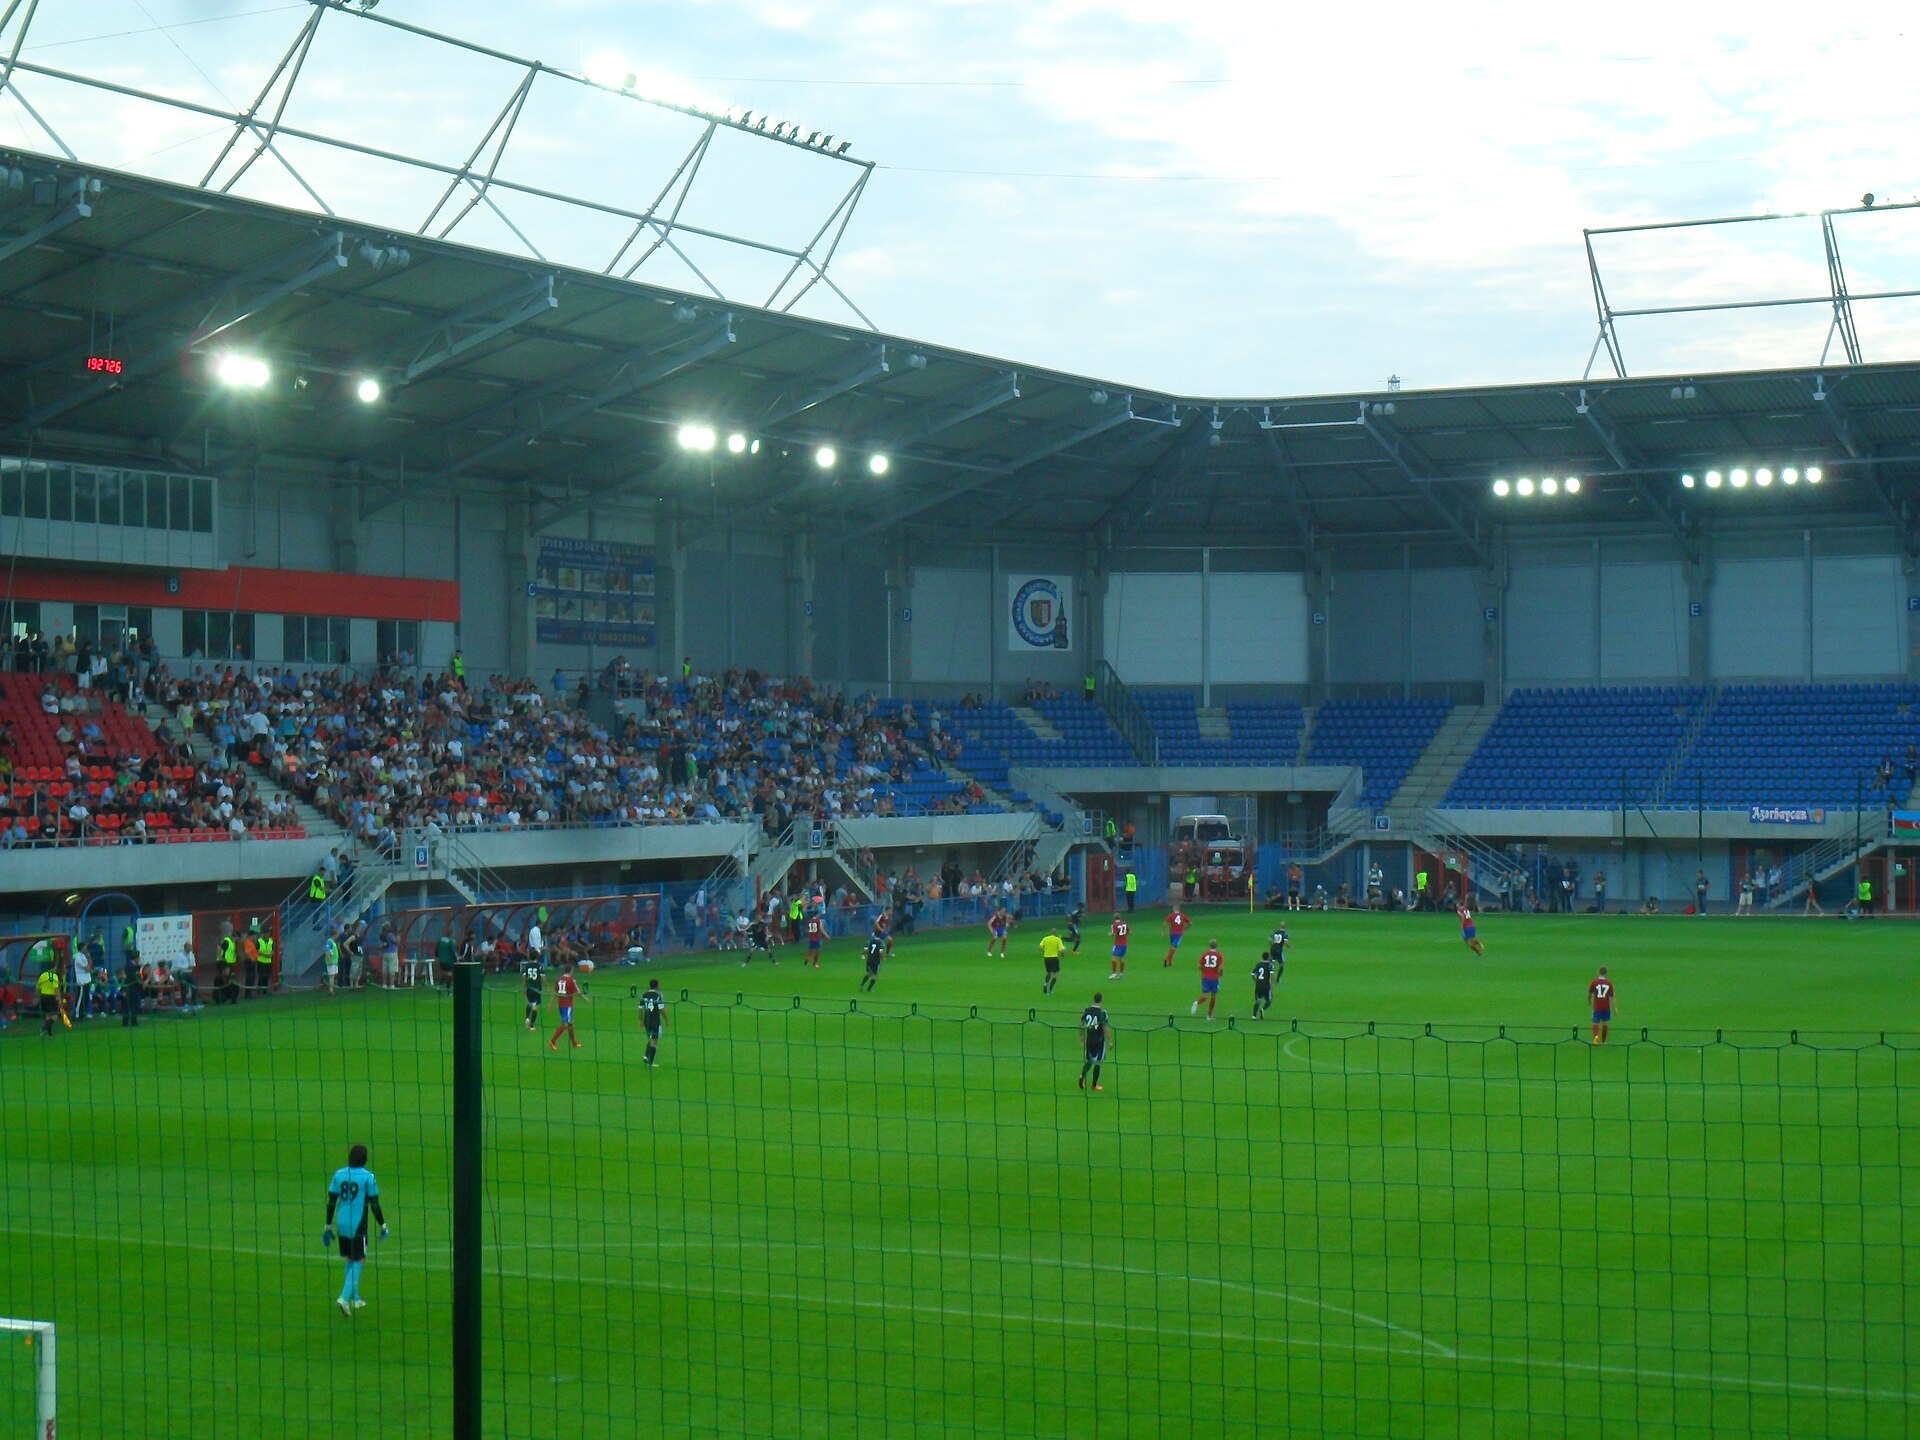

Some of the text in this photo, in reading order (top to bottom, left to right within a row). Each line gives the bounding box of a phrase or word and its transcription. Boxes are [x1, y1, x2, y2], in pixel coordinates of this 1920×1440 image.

[169, 578, 178, 593] B
[528, 583, 536, 597] C
[1690, 603, 1699, 616] E
[1910, 598, 1918, 609] F
[1485, 608, 1494, 621] E
[1174, 915, 1181, 925] 4
[1117, 924, 1127, 936] 27
[871, 943, 877, 954] 7
[1204, 955, 1217, 968] 13
[527, 968, 537, 981] 55
[1258, 967, 1264, 980] 2
[558, 980, 567, 994] 11
[1596, 984, 1610, 998] 17
[1086, 1014, 1099, 1030] 24
[340, 1181, 359, 1202] 89
